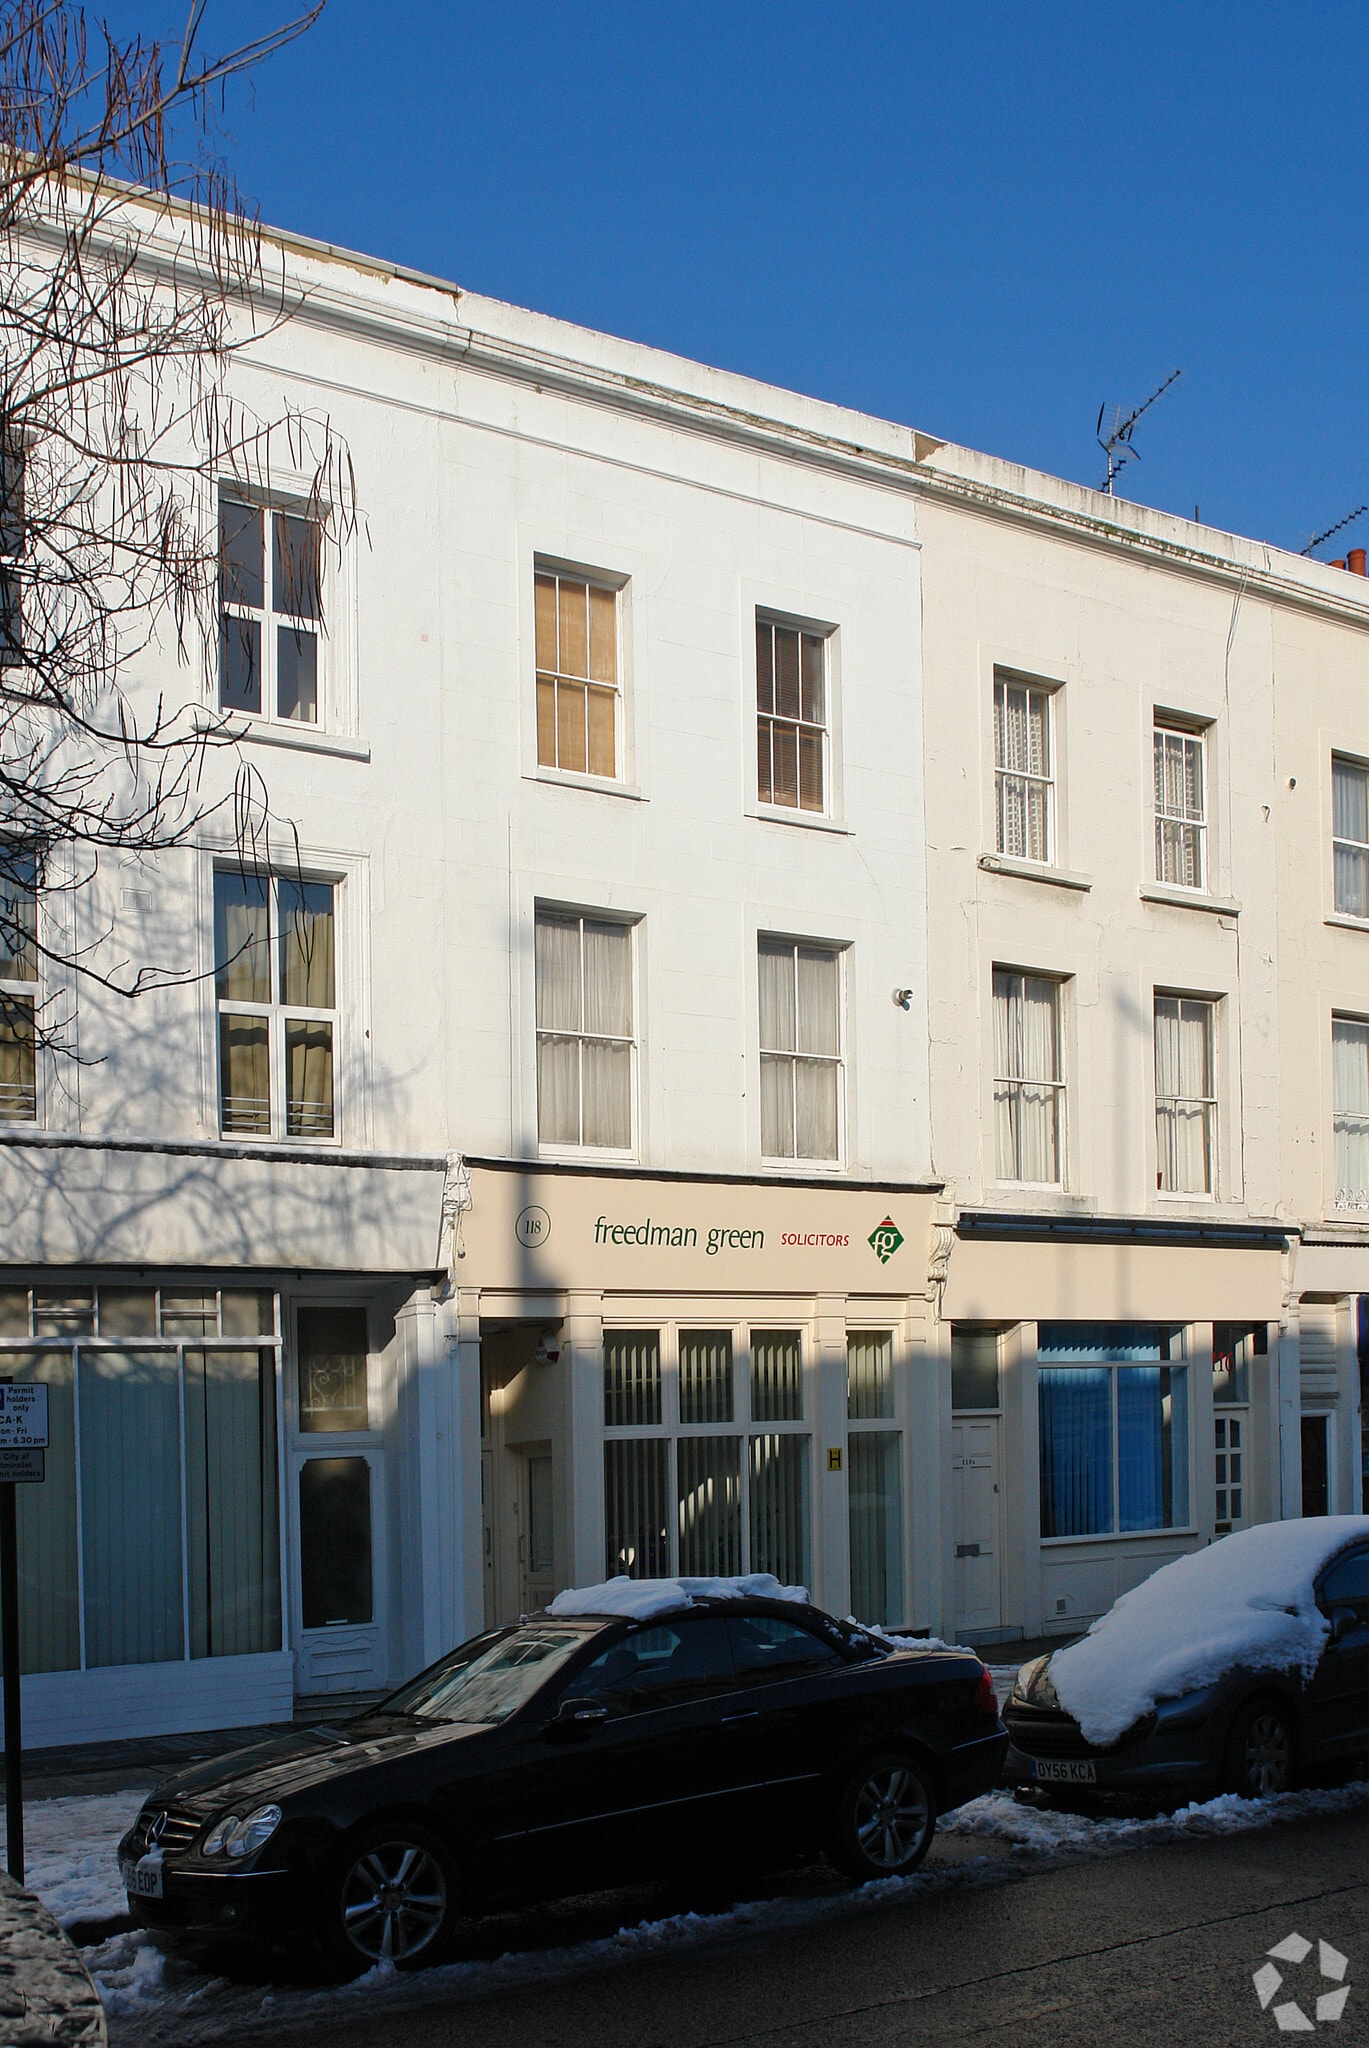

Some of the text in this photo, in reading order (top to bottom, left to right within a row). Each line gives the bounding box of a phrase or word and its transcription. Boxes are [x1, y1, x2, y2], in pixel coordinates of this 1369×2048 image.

[525, 1219, 542, 1235] 118
[594, 1216, 850, 1255] freedman green SOLICITORS
[8, 1386, 34, 1394] Permit
[7, 1395, 36, 1403] holders
[13, 1404, 30, 1413] only
[16, 1426, 27, 1434] Fri
[13, 1436, 32, 1444] 6.30
[3, 1452, 30, 1461] City of
[829, 1450, 841, 1469] H
[12, 1469, 41, 1477] holders
[1069, 1763, 1095, 1780] KCA
